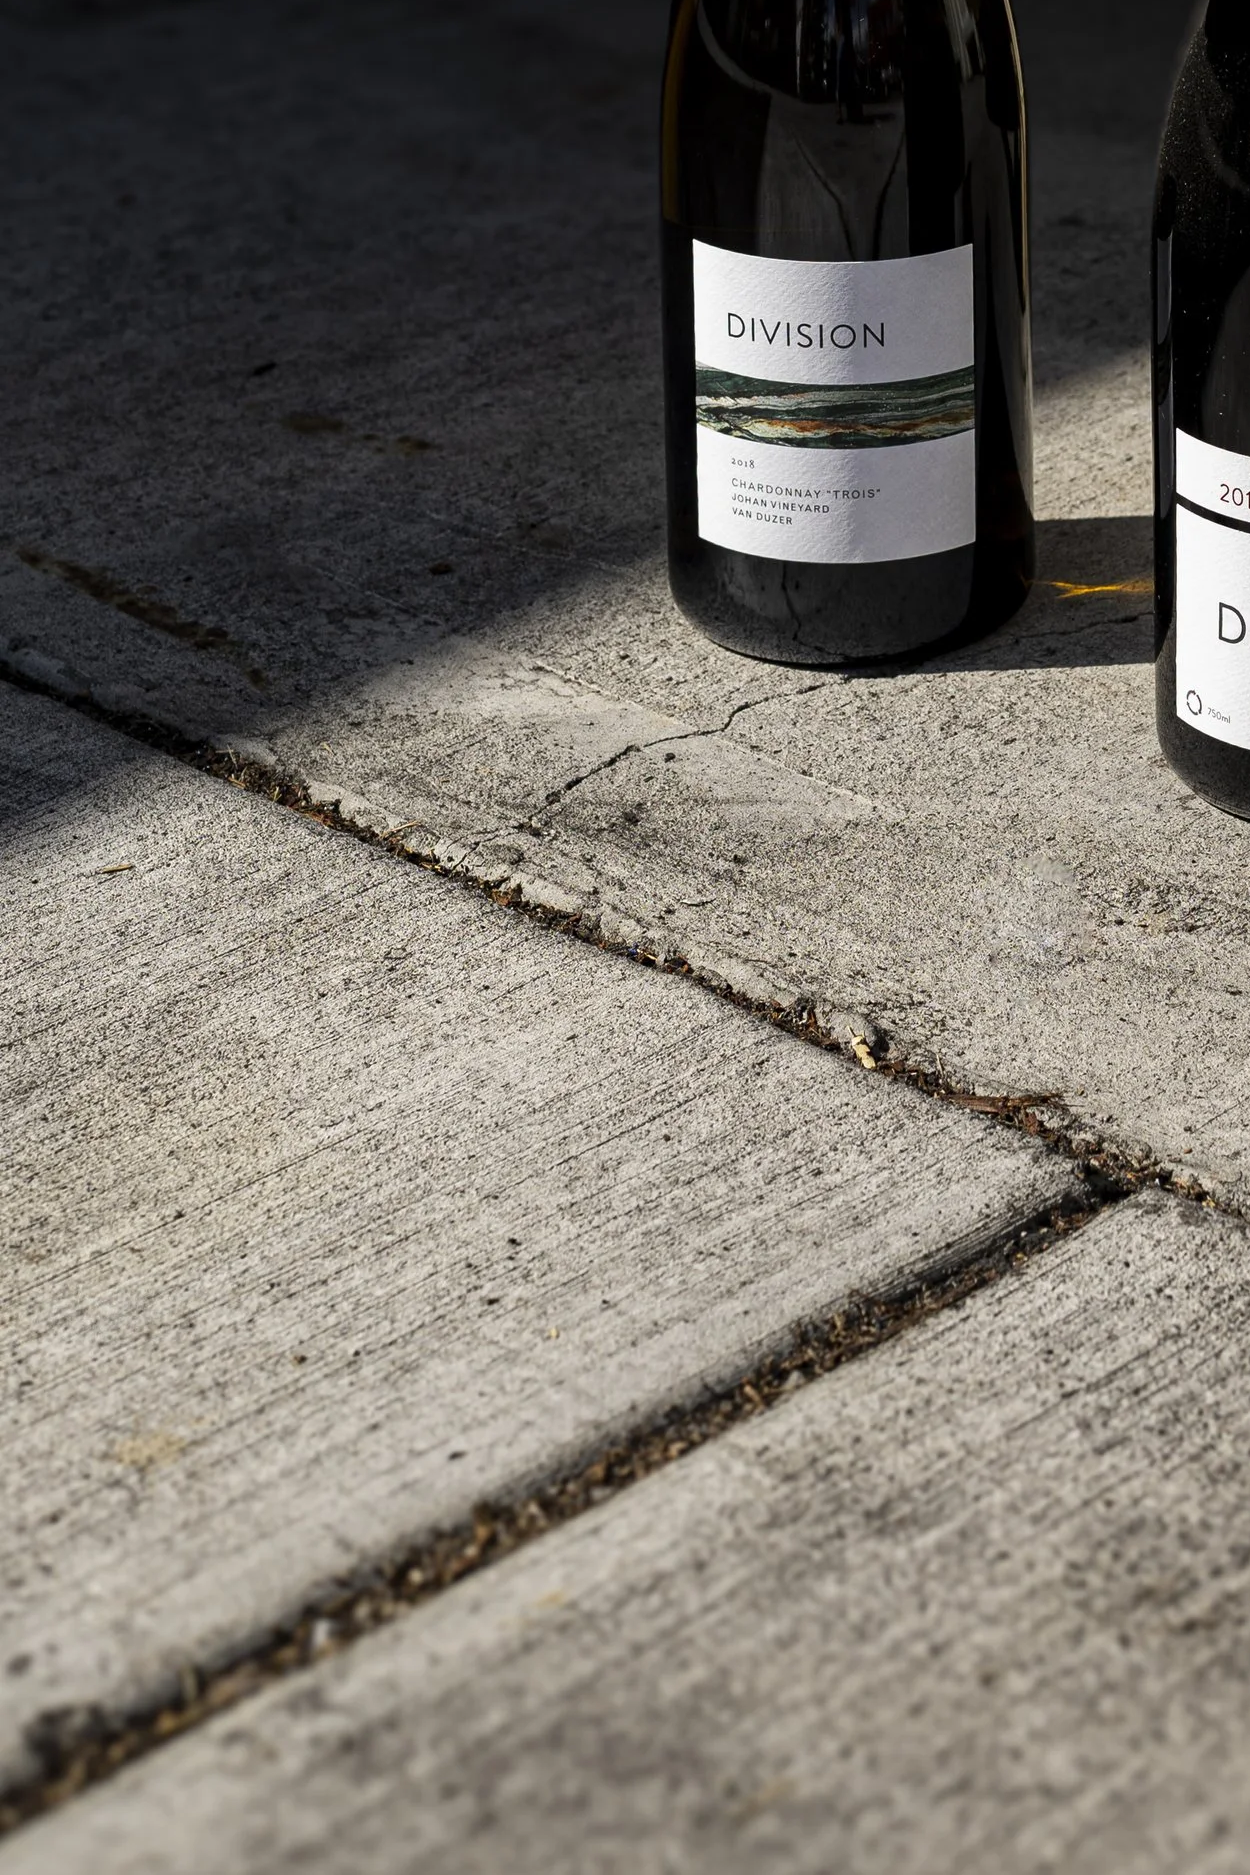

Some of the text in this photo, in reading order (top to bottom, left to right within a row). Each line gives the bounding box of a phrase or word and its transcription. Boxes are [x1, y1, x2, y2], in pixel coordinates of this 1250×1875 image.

[727, 312, 886, 349] DIVISION
[731, 457, 756, 470] 2018
[731, 477, 882, 500] CHARDONNAY "TROIS"
[731, 492, 830, 514] JOHAN VINEYARD
[731, 507, 794, 526] VAN DUZER
[1207, 706, 1232, 725] 750ml
